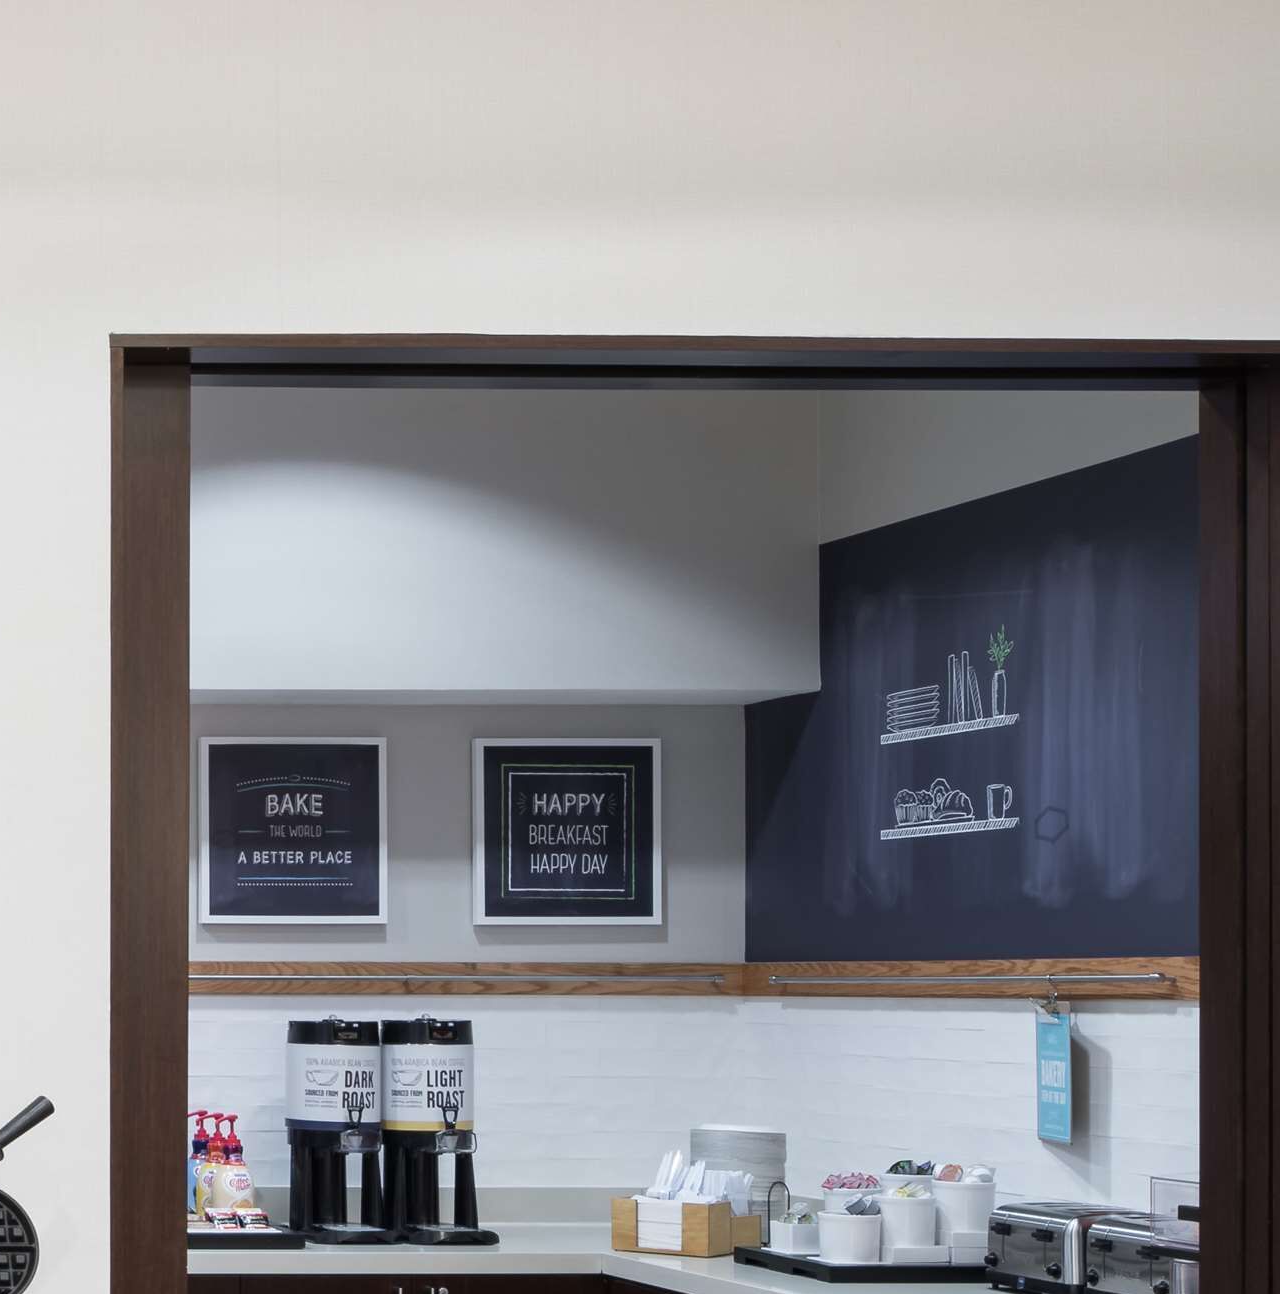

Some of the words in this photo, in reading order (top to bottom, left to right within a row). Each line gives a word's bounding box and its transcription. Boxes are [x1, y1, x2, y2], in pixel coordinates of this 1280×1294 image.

[265, 792, 323, 817] BAKE
[532, 793, 605, 816] HAPPY
[269, 825, 286, 838] THE
[289, 825, 322, 838] WORLD
[528, 824, 609, 846] BREAKFAST
[237, 851, 247, 864] A
[253, 851, 304, 864] BETTER
[310, 851, 352, 864] PLACE
[530, 854, 577, 875] HAPPY
[581, 854, 608, 875] DAY
[344, 1070, 374, 1088] DARK
[426, 1070, 463, 1087] LIGHT
[325, 1089, 338, 1097] FROM
[342, 1091, 375, 1109] ROAST
[427, 1090, 464, 1109] ROAST
